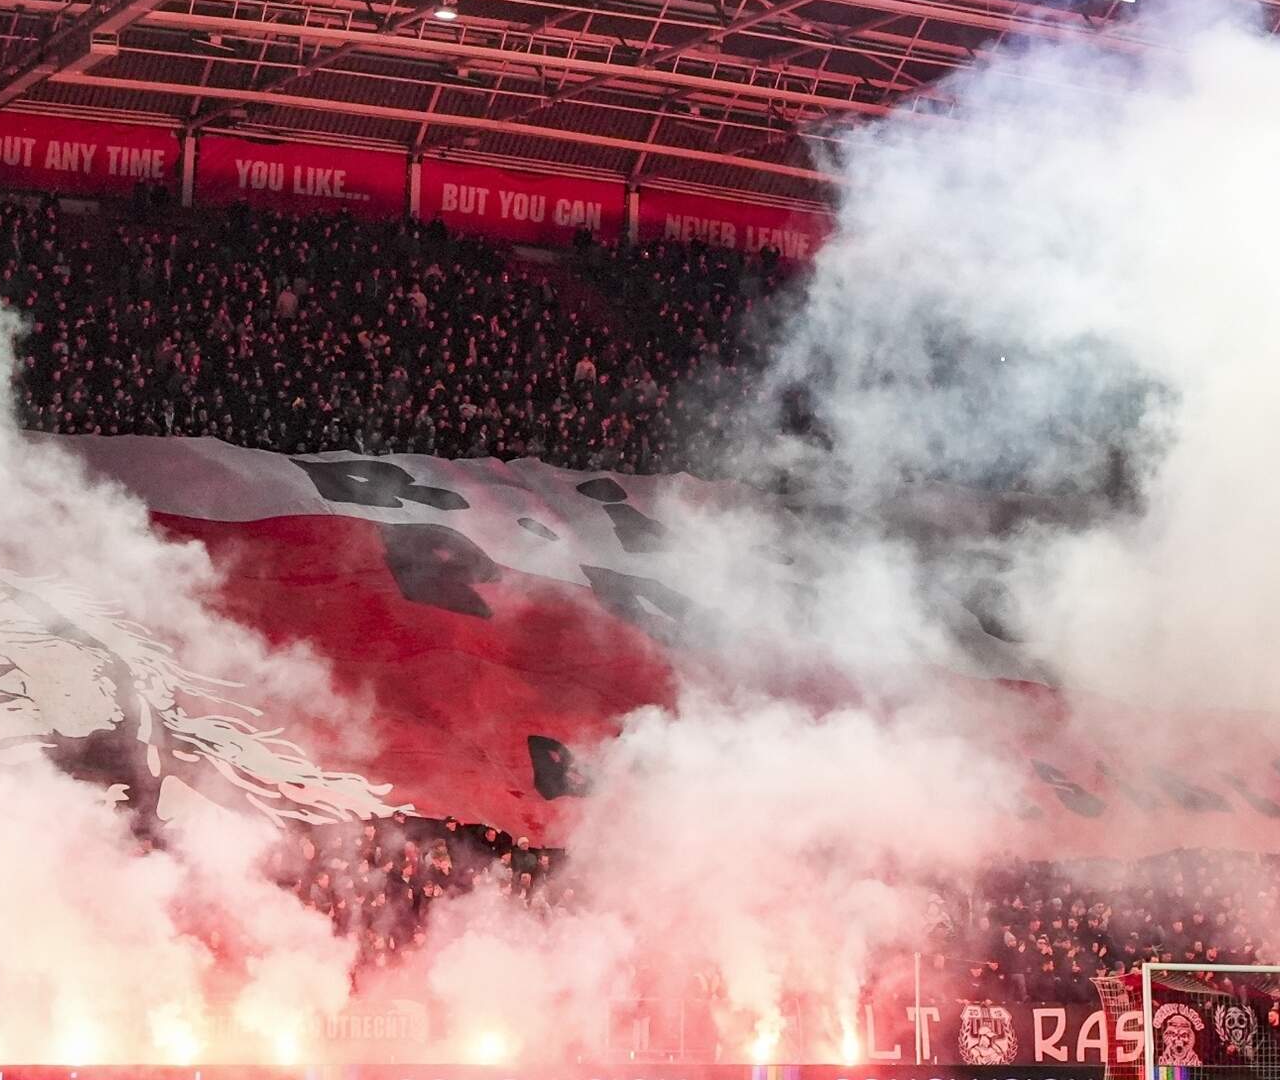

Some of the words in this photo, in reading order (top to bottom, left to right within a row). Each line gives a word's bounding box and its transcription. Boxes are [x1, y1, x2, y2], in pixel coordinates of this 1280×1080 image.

[44, 140, 98, 175] ANY
[106, 146, 166, 179] TIME
[235, 159, 285, 192] YOU
[292, 165, 371, 201] LIKE...
[441, 183, 490, 216] BUT
[498, 190, 547, 223] YOU
[554, 198, 602, 231] CAN
[664, 213, 736, 249] NEVER
[746, 225, 812, 260] LEAVE
